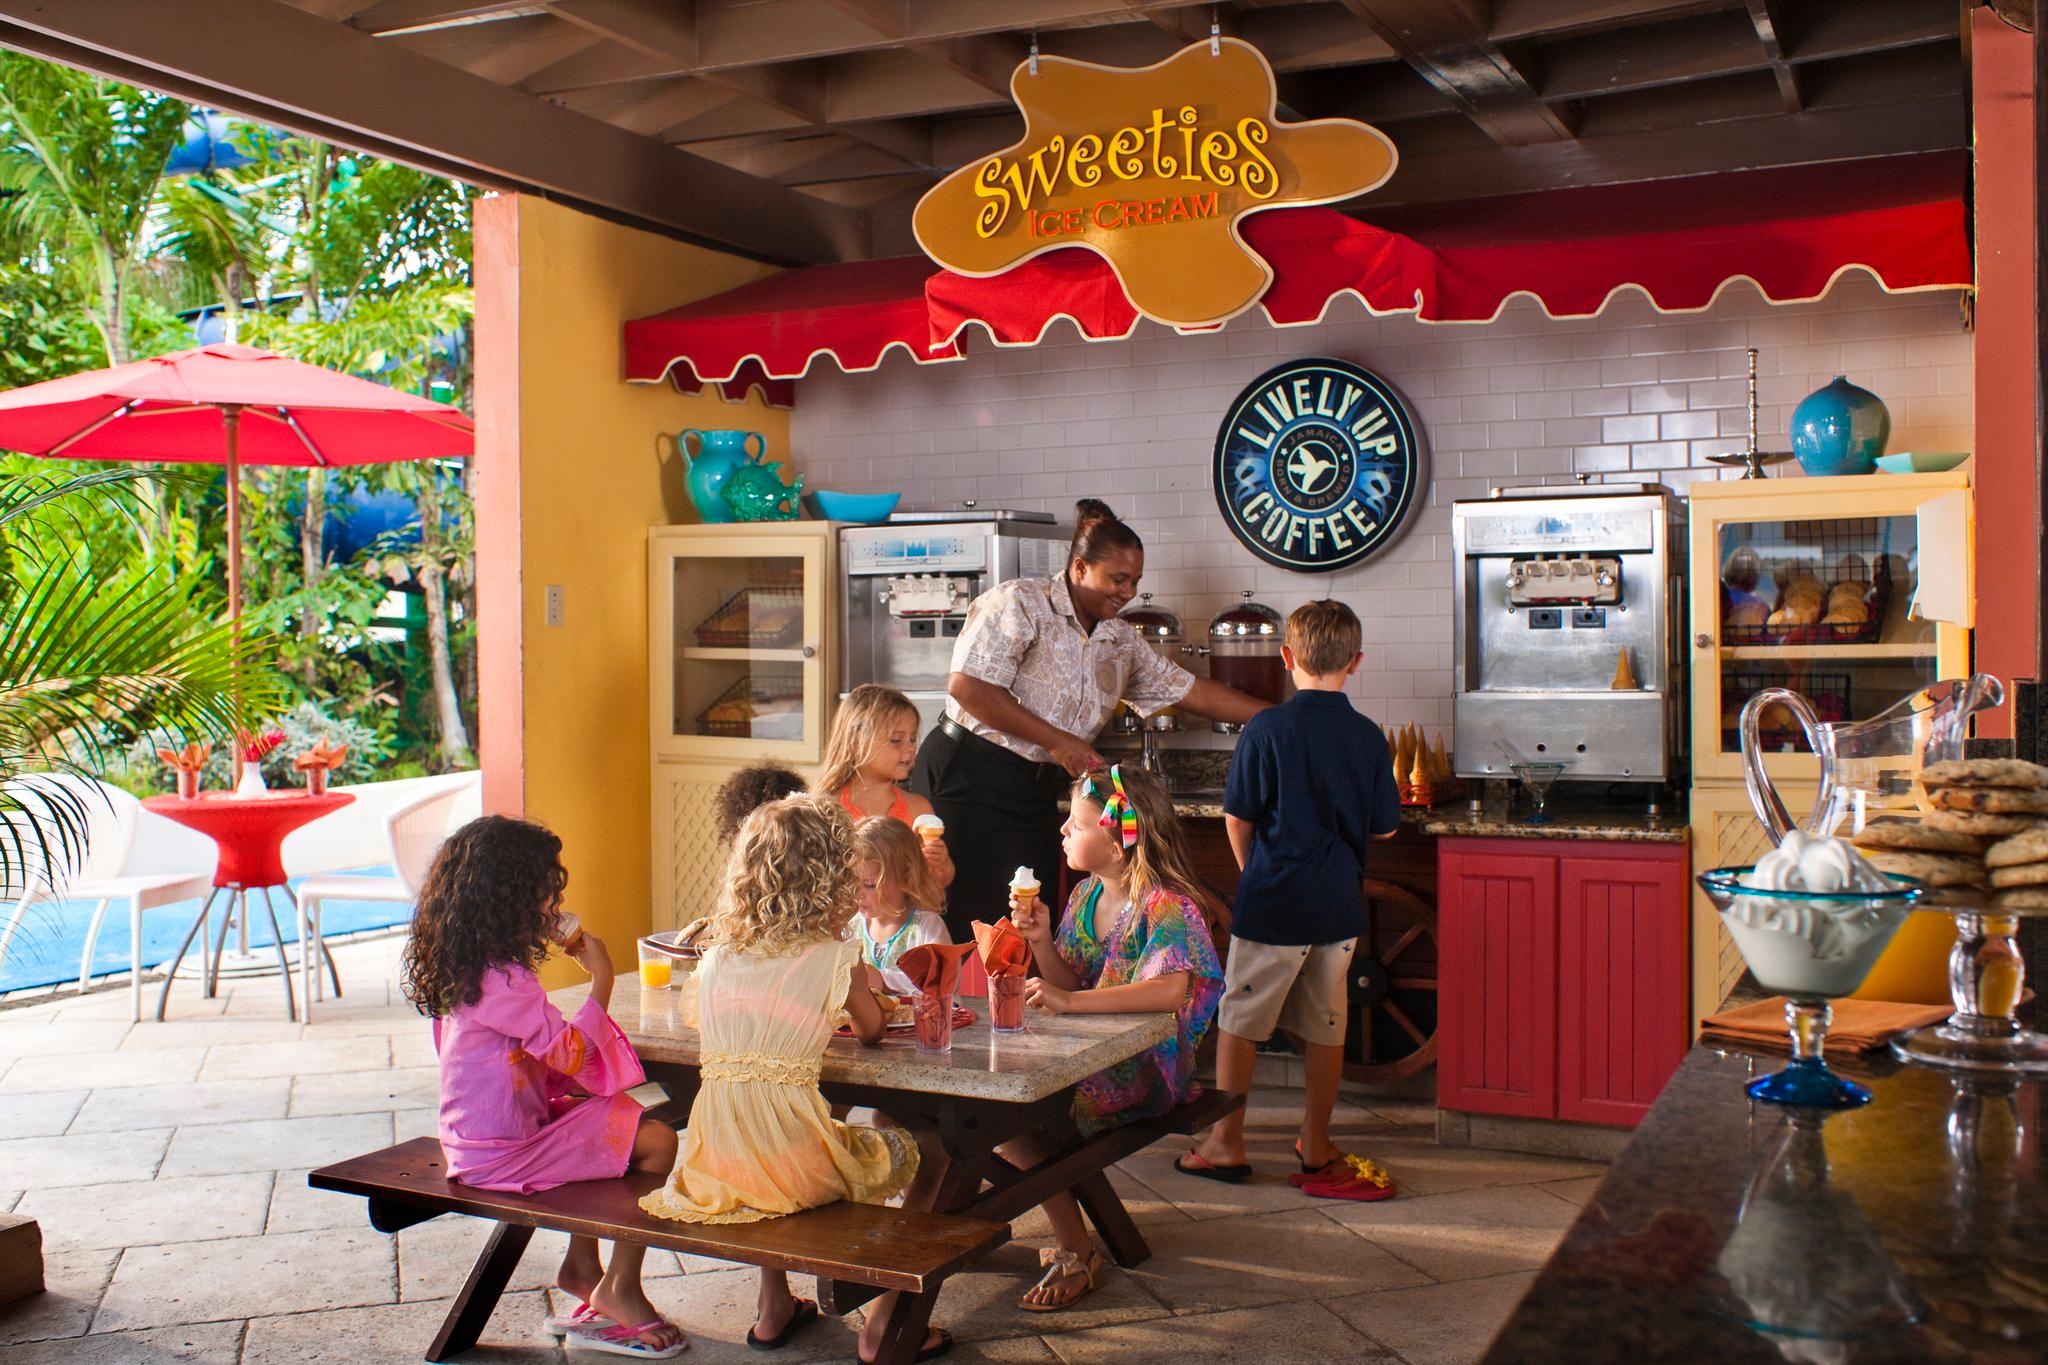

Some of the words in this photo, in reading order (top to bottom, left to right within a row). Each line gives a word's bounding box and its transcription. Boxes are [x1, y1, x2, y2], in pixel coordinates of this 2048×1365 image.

[1237, 376, 1363, 449] LIVELY
[1351, 406, 1398, 457] UP
[1289, 428, 1344, 452] JAMAICA
[1241, 491, 1378, 555] COFFEE
